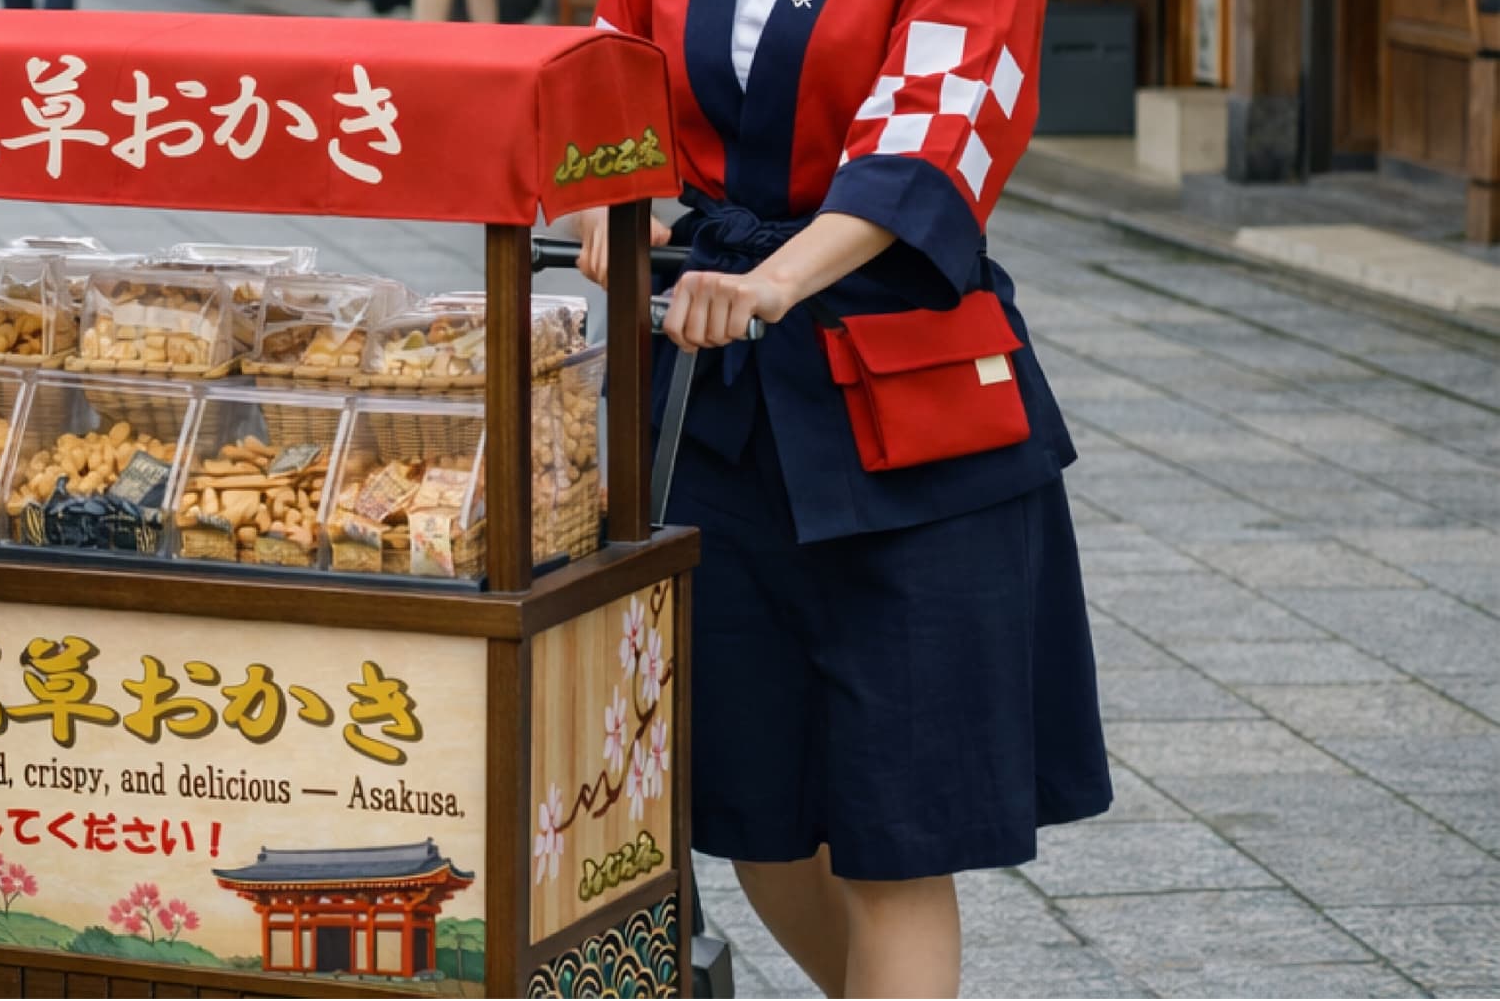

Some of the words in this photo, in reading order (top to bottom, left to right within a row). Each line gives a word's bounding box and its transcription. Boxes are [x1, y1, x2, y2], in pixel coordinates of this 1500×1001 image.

[24, 757, 111, 797] crispy,
[120, 761, 168, 795] and
[178, 764, 292, 804] delicious
